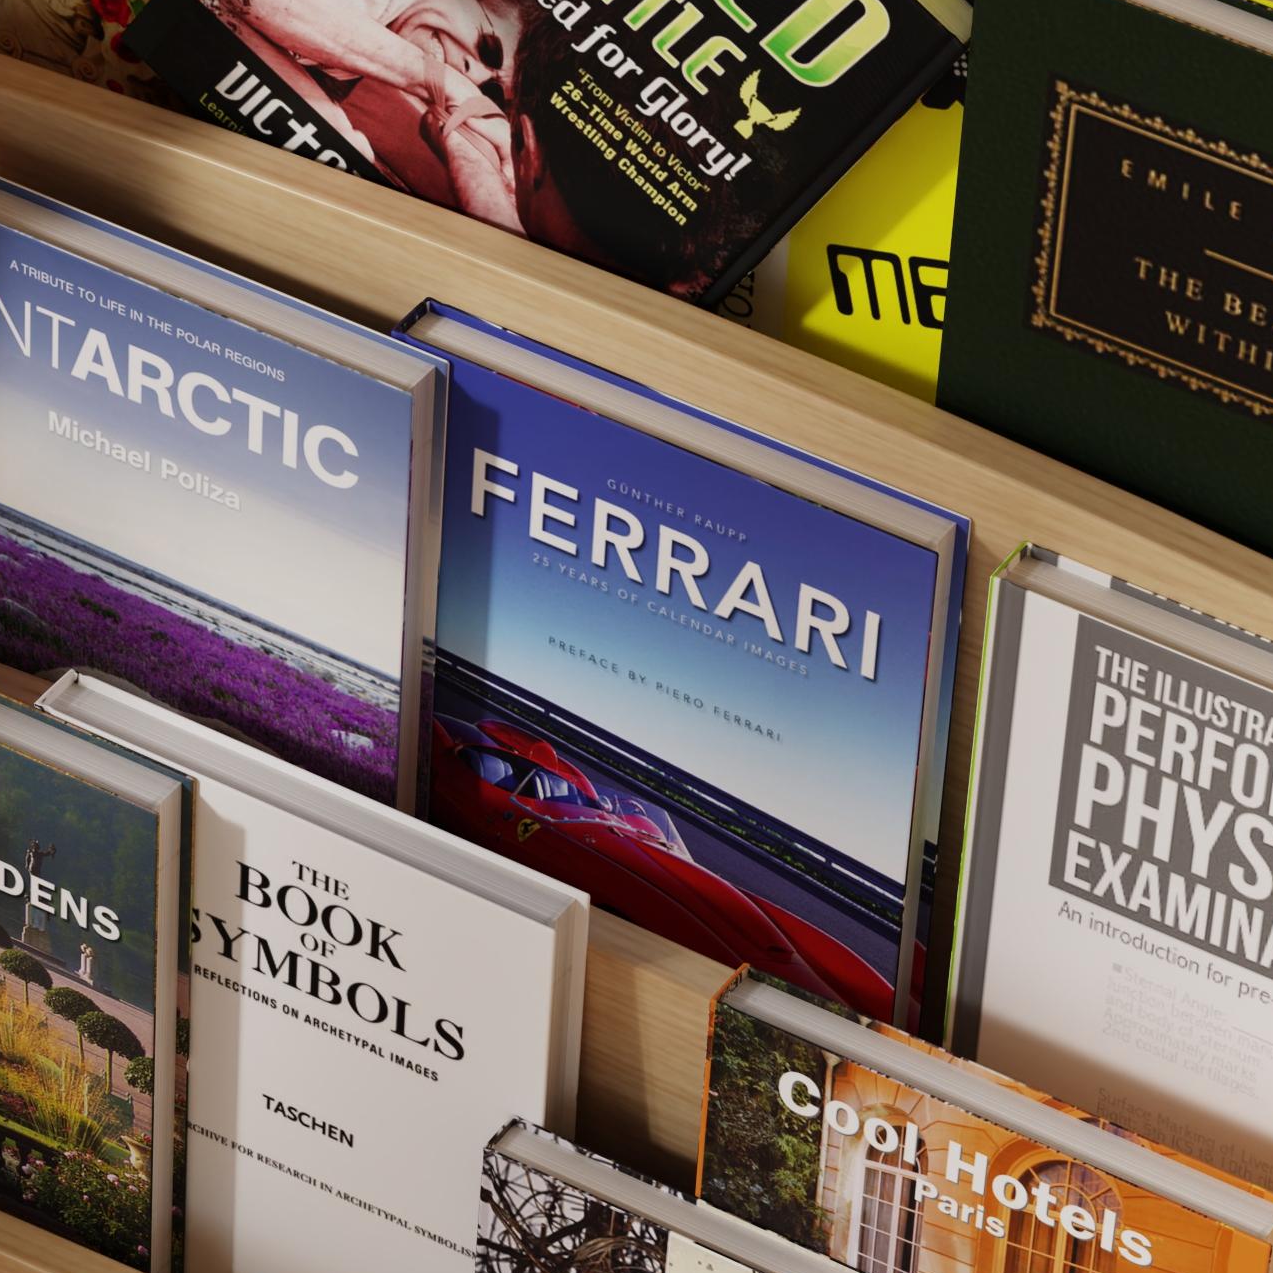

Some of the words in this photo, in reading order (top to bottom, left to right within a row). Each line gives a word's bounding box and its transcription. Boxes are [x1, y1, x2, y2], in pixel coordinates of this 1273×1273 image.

[571, 23, 644, 79] for
[636, 78, 752, 183] Glory!
[615, 104, 652, 144] Victim
[653, 142, 666, 157] to
[550, 92, 616, 160] Wrestling
[618, 158, 687, 226] Champion
[625, 139, 667, 182] World
[667, 182, 698, 212] Arm
[1121, 158, 1246, 222] EMILE
[9, 259, 20, 272] A
[21, 261, 74, 295] TRIBUTE
[76, 286, 97, 304] TO
[99, 294, 127, 317] LIFE
[129, 306, 143, 323] IN
[147, 313, 173, 337] THE
[175, 327, 222, 357] POLAR
[225, 347, 286, 383] REGIONS
[1135, 257, 1203, 301] THE
[48, 409, 152, 474] Michael
[161, 456, 241, 512] Poliza
[470, 447, 882, 681] FERRARI
[695, 512, 747, 544] RAUPP
[532, 551, 551, 569] 25
[558, 562, 609, 593] YEARS
[617, 586, 639, 606] OF
[646, 599, 735, 648] CALENDAR
[743, 641, 809, 678] IMAGES
[548, 635, 619, 675] PREFACE
[627, 669, 647, 686] BY
[655, 680, 704, 711] PIERO
[713, 704, 782, 743] FERRARI
[1094, 644, 1147, 691] THE
[234, 861, 406, 971] BOOK
[292, 861, 350, 902] THE
[300, 932, 337, 960] OF
[1057, 899, 1082, 925] An
[1088, 911, 1199, 976] introduction
[1206, 962, 1234, 988] for
[194, 964, 278, 1010] REFLECTIONS
[282, 1002, 300, 1019] ON
[303, 1015, 386, 1060] ARCHETYPAL
[390, 1052, 440, 1082] IMAGES
[262, 1093, 354, 1147] TASCHEN
[231, 1141, 254, 1158] FOR
[256, 1152, 318, 1187] RESEARCH
[321, 1182, 333, 1194] IN
[335, 1190, 412, 1231] ARCHETYPAL
[778, 1071, 921, 1163] Cool
[945, 1139, 1155, 1268] Hotels
[913, 1174, 1005, 1239] Paris
